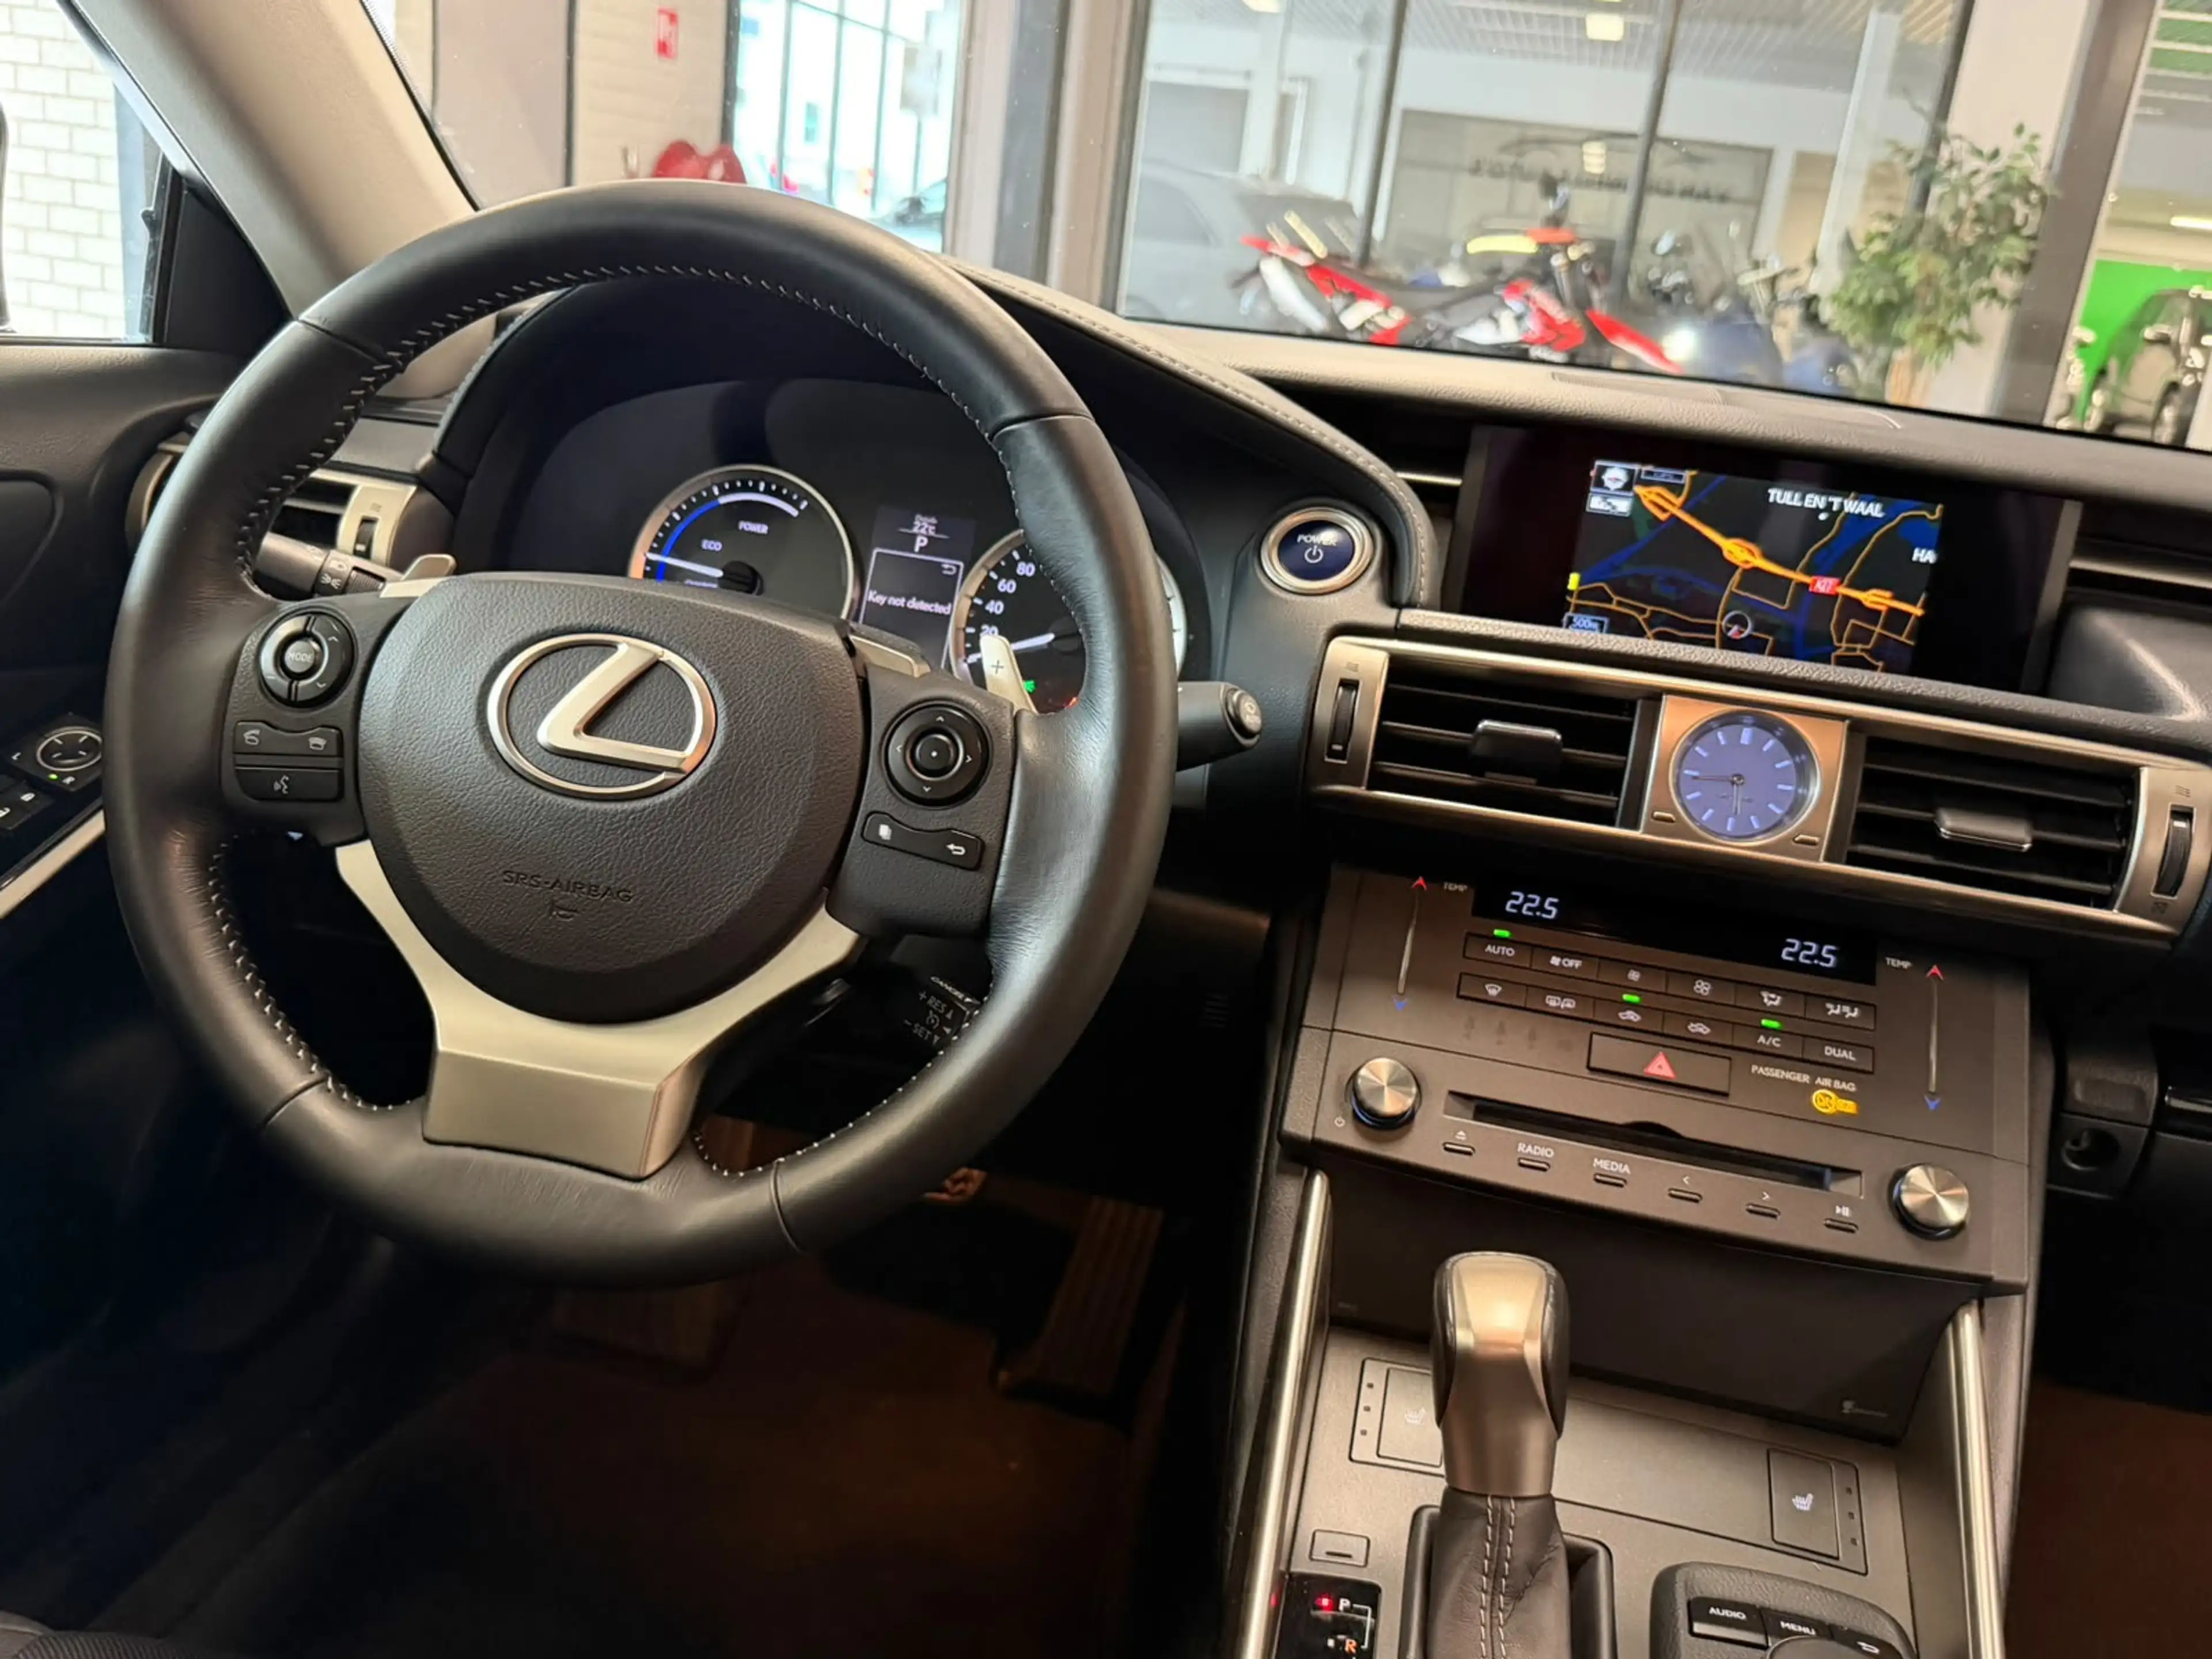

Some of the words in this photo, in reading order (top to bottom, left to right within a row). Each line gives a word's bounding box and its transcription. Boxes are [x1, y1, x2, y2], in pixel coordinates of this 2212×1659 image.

[1768, 488, 1802, 507] TULL
[1804, 493, 1826, 509] EN
[1843, 499, 1885, 518] WAAL
[738, 520, 768, 535] POWER
[701, 539, 722, 552] ECO
[914, 536, 929, 552] P
[1912, 548, 1937, 564] HA
[1016, 561, 1036, 577] 80
[997, 578, 1017, 593] 60
[868, 590, 887, 606] Key
[888, 595, 906, 607] not
[907, 596, 952, 615] detected
[984, 599, 1004, 615] 40
[980, 624, 999, 636] 20
[288, 652, 313, 663] MODE
[1443, 881, 1468, 892] TEMP
[1505, 891, 1559, 919] 22.5
[1484, 944, 1516, 957] AUTO
[1781, 938, 1838, 968] 22.5
[1562, 958, 1582, 970] OFF
[1885, 956, 1912, 969] TEMP
[1757, 1035, 1782, 1048] A/C
[1824, 1046, 1857, 1061] DUAL
[1751, 1065, 1811, 1084] PASSENGER
[1815, 1076, 1831, 1088] AIR
[1833, 1081, 1857, 1093] BAG
[1517, 1142, 1554, 1158] RADIO
[1593, 1157, 1631, 1175] MEDIA
[1338, 1597, 1351, 1612] P
[1709, 1607, 1747, 1621] AUDIO
[1780, 1620, 1817, 1635] MENU
[1344, 1638, 1358, 1655] R
